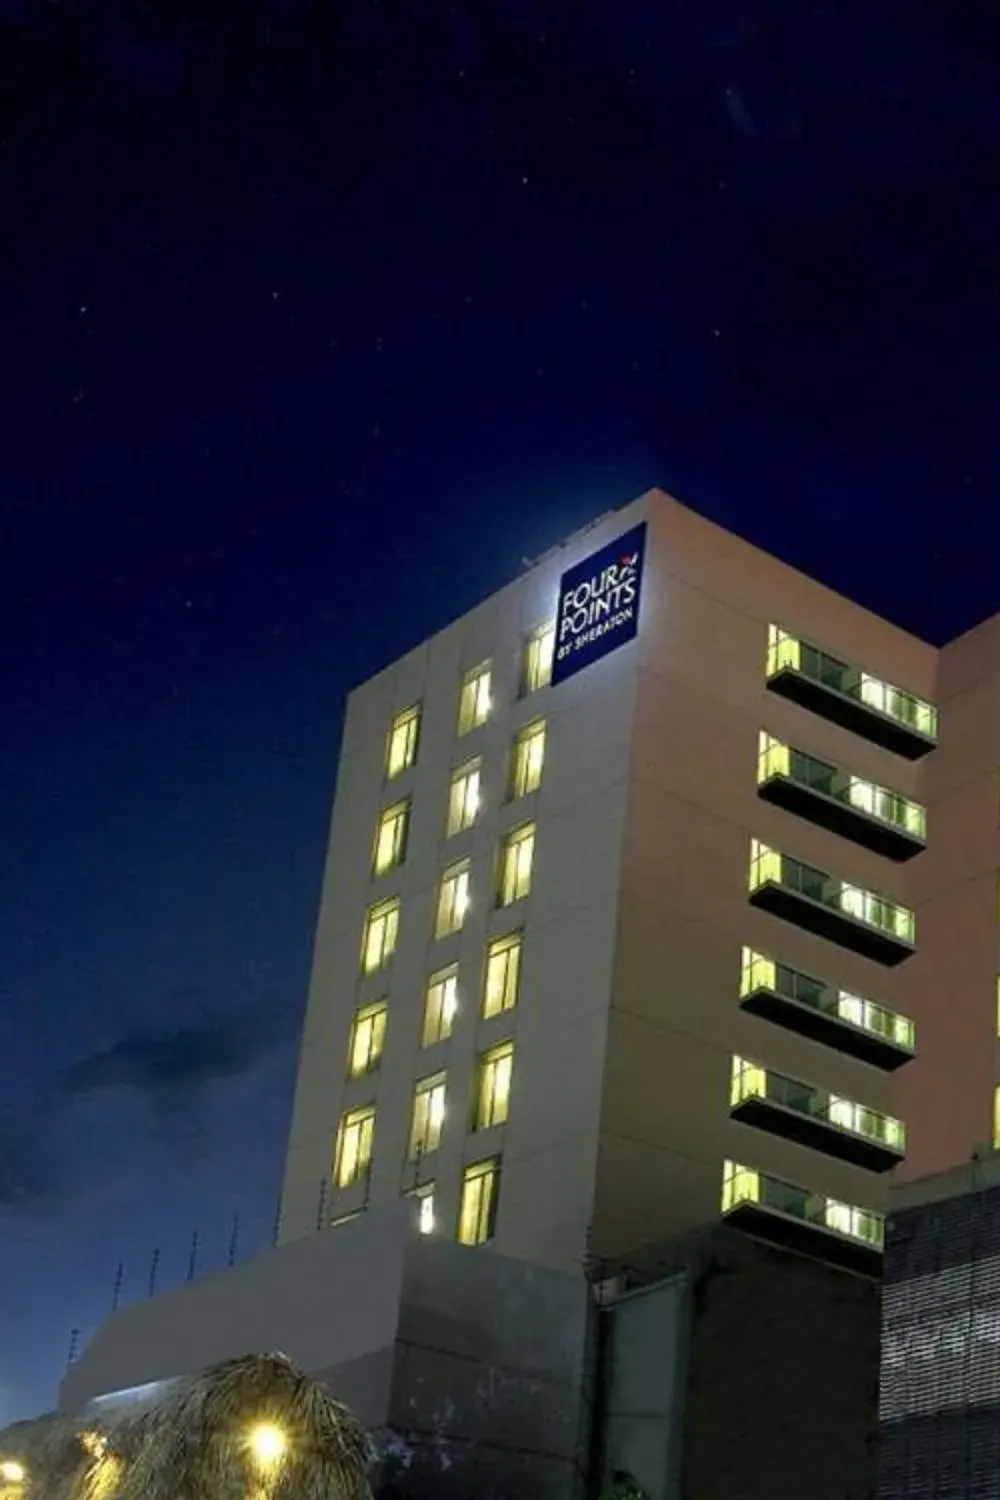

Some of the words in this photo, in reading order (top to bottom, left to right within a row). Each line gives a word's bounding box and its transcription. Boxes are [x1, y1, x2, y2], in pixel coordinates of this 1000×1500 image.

[559, 576, 636, 641] POINTS
[563, 564, 618, 616] FOUR
[557, 644, 572, 660] BY
[575, 607, 634, 650] SHERATON
